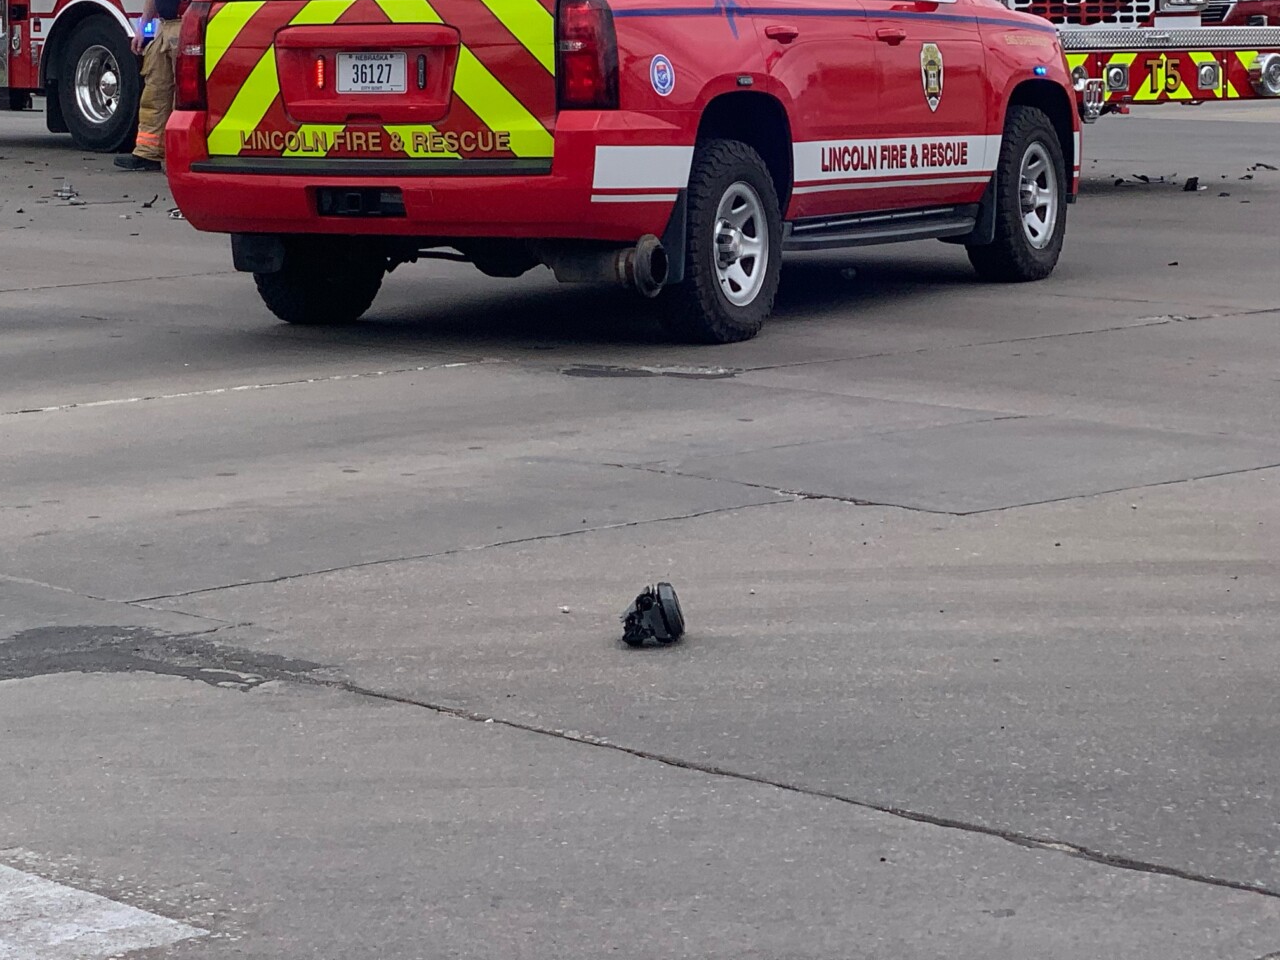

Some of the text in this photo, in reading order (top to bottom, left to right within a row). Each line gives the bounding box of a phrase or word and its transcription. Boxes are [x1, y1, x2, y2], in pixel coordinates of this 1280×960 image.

[355, 53, 389, 61] NEBRASKA
[352, 63, 392, 84] 36127
[1145, 59, 1181, 93] T5
[240, 130, 511, 153] LINCOLN FIRE & RESCUE
[821, 141, 968, 172] LINCOLN FIRE & RESCUE
